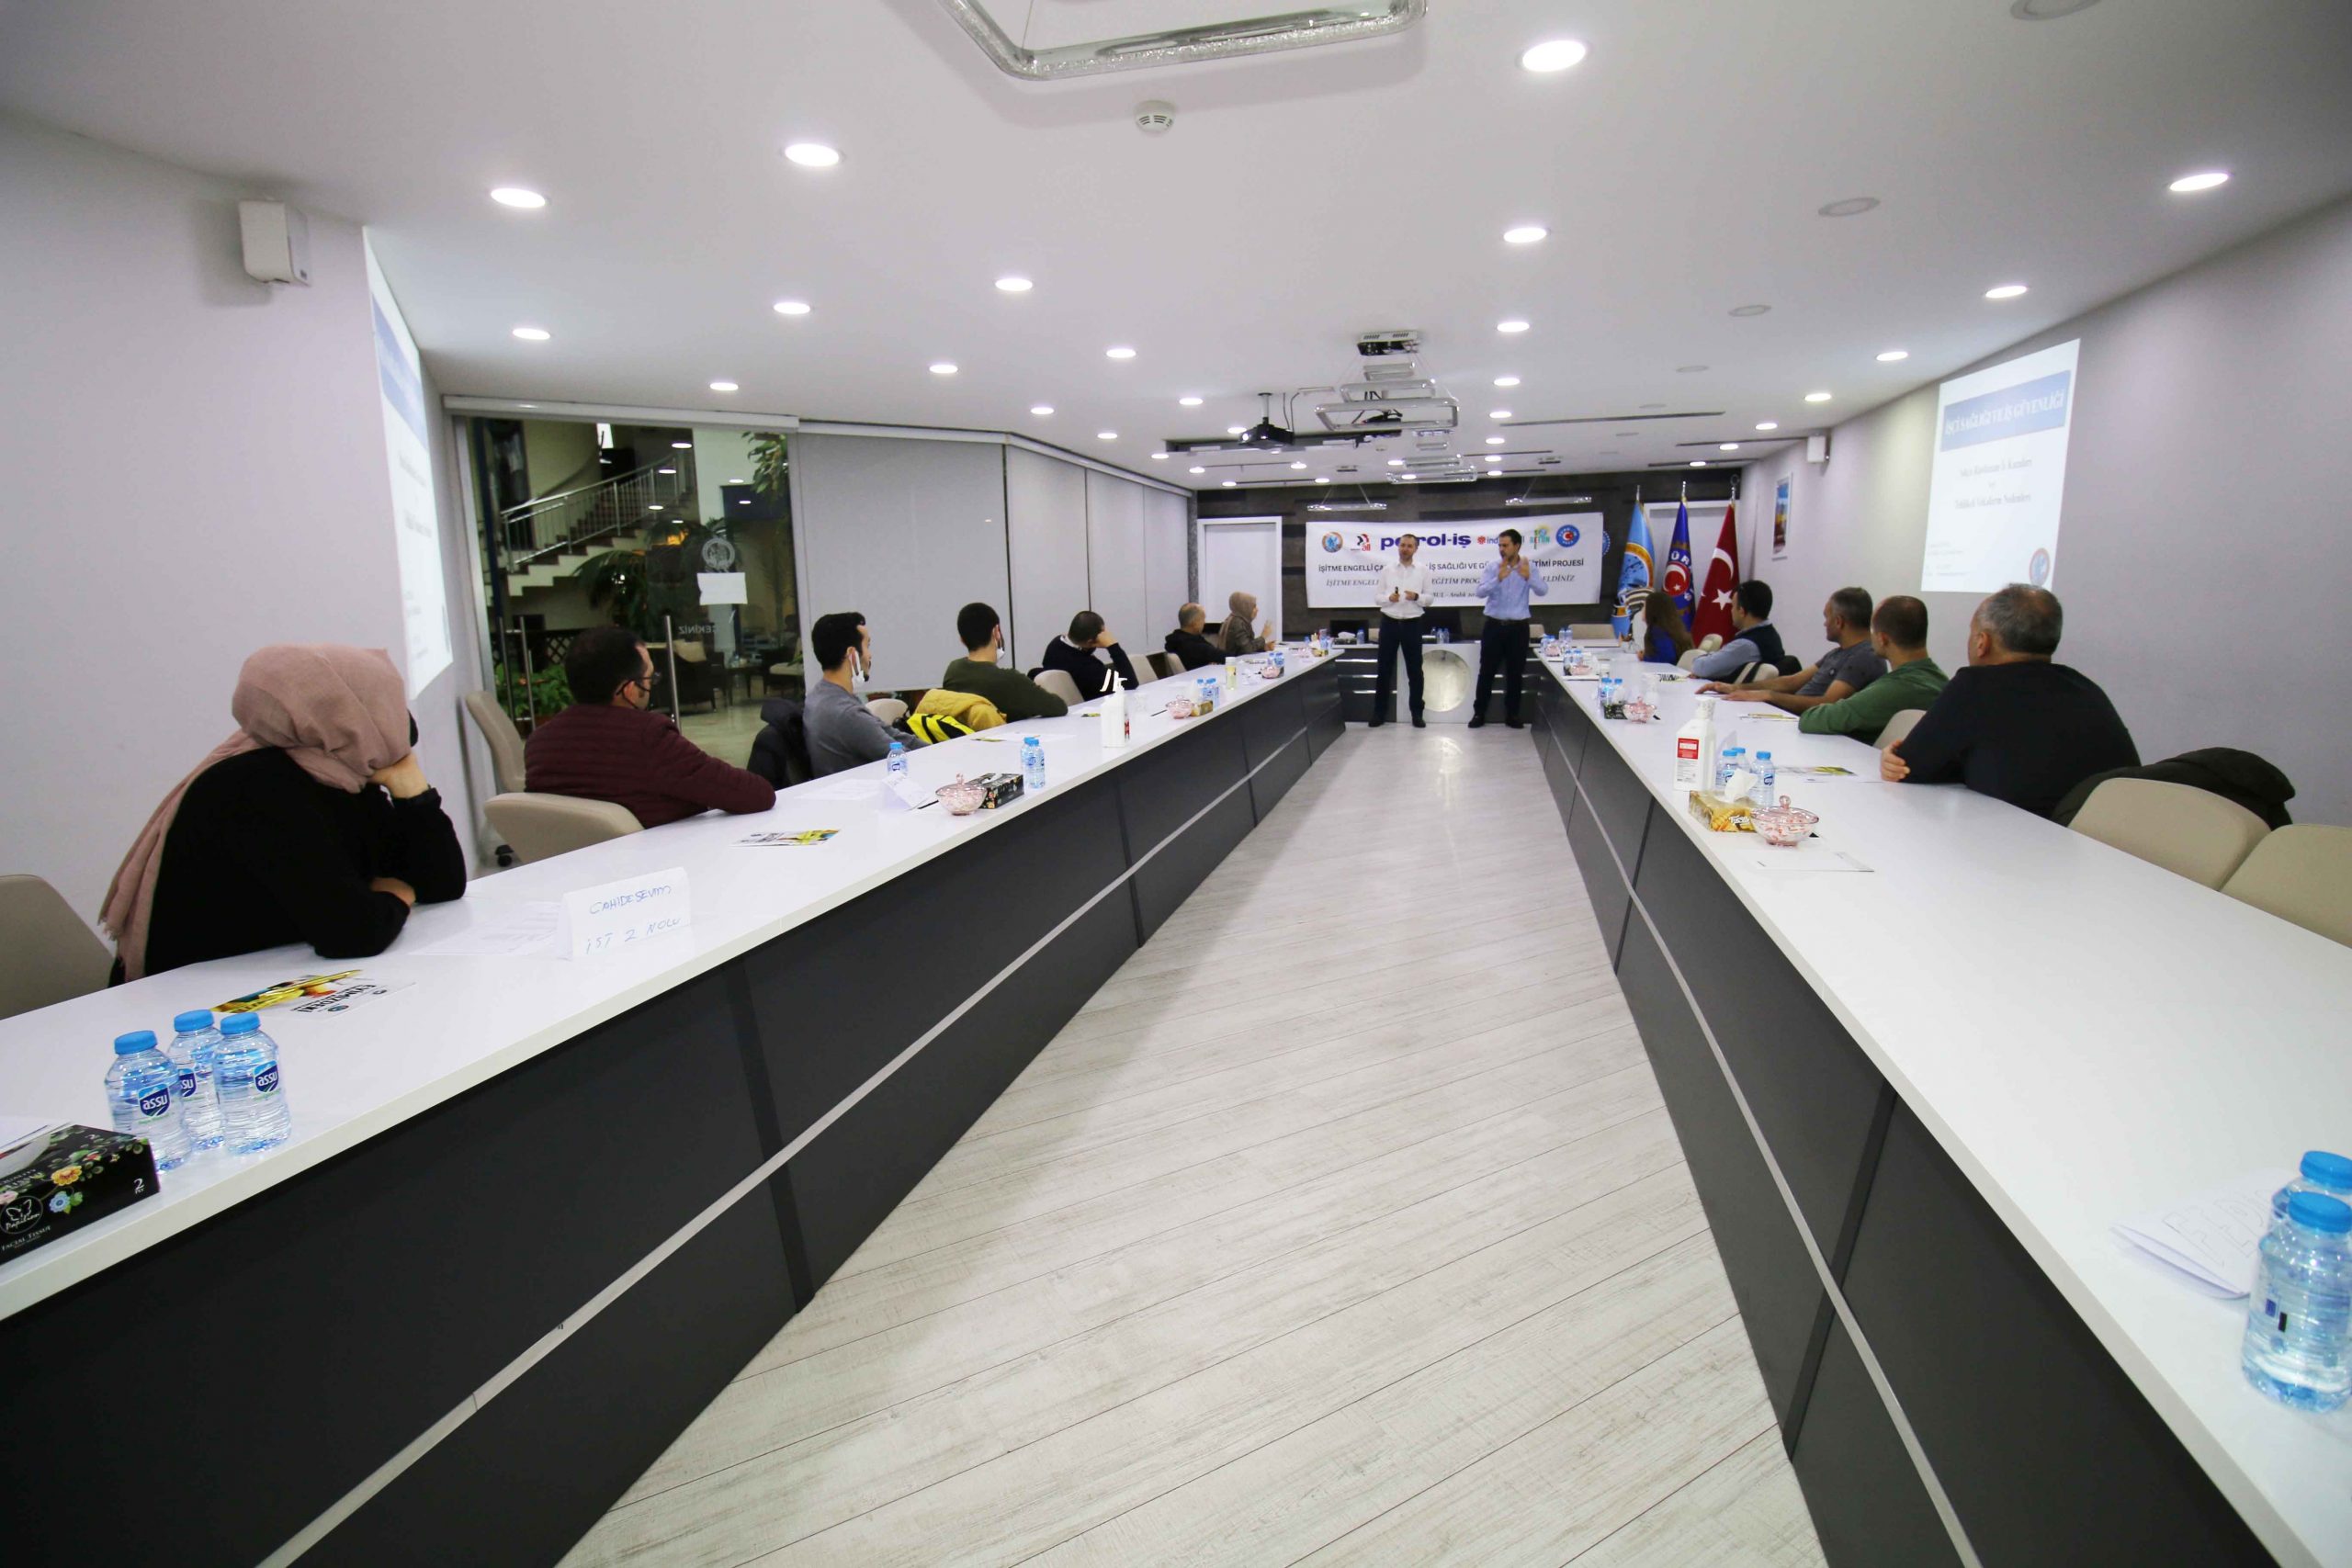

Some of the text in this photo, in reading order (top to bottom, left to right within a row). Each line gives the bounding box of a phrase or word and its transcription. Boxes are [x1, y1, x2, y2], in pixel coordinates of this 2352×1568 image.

[1318, 564, 1342, 573] İŞİTME
[1343, 563, 1374, 571] ENGELLİ
[1429, 563, 1436, 571] İŞ
[1437, 561, 1467, 570] SAĞLIĞI
[1552, 558, 1584, 567] PROJESİ
[257, 1070, 277, 1087] assu
[142, 1094, 168, 1111] assu
